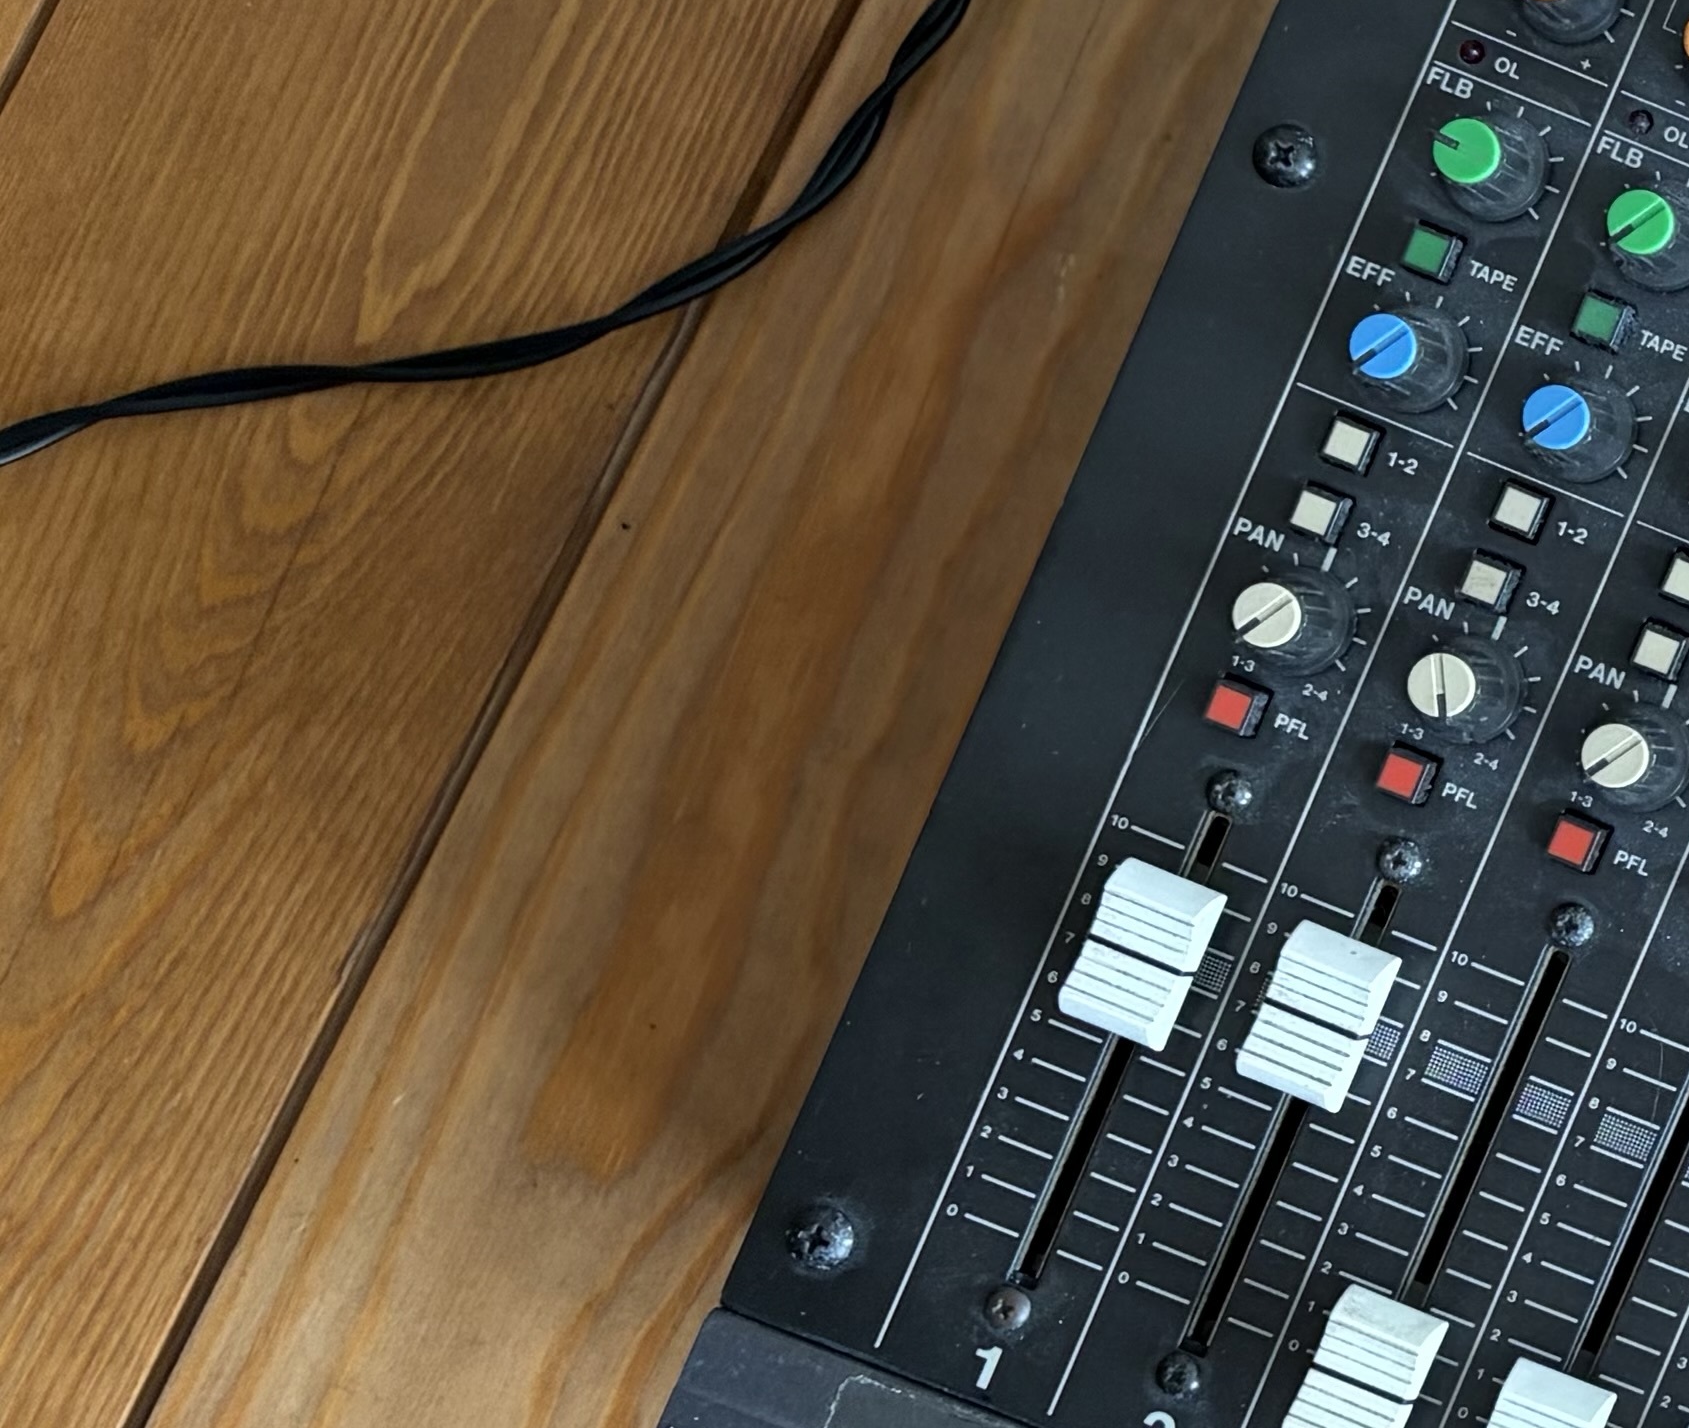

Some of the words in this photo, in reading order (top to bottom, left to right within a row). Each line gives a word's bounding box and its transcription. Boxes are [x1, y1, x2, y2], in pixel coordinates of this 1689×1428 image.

[1425, 66, 1474, 99] FLB
[1596, 135, 1644, 169] FLB
[1345, 255, 1397, 287] EFF
[1469, 259, 1519, 293] TAPE
[1514, 324, 1565, 356] EFF
[1233, 516, 1286, 553] PAN
[1557, 521, 1589, 545] 1-2
[1403, 585, 1456, 621] PAN
[1573, 654, 1626, 690] PAN
[1273, 712, 1309, 741] PFL
[1613, 849, 1649, 877] PFL
[1451, 950, 1469, 967] 10
[975, 1345, 1003, 1390] 1
